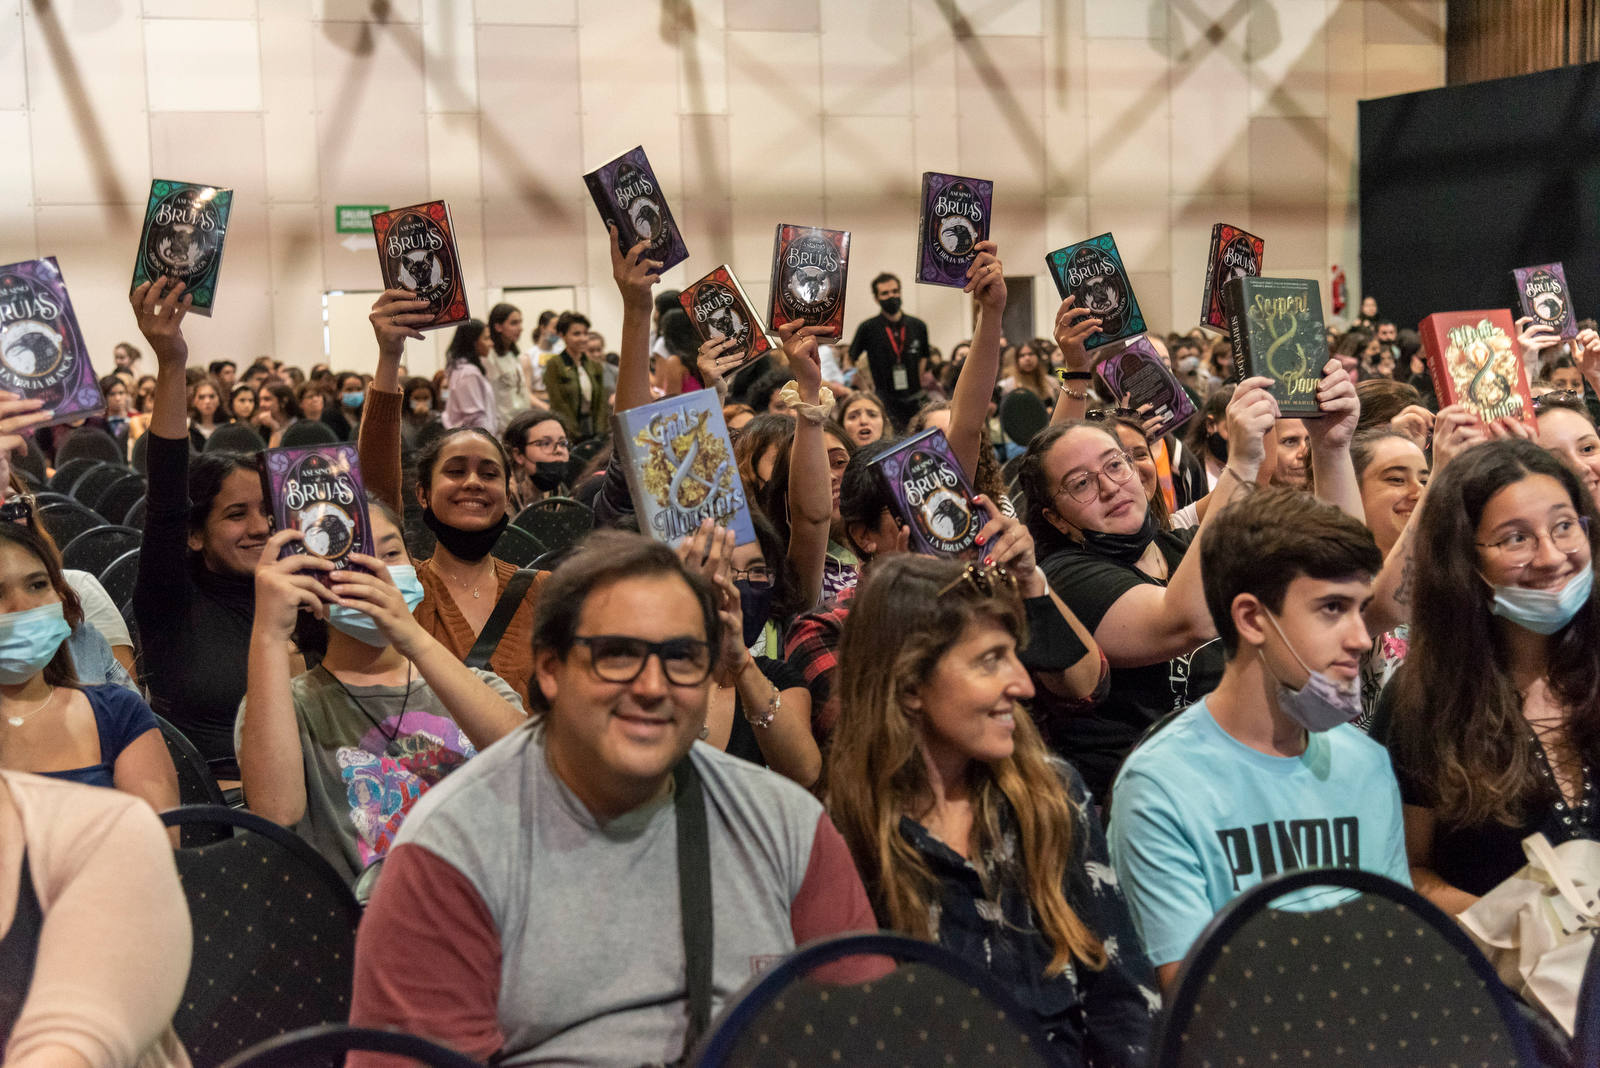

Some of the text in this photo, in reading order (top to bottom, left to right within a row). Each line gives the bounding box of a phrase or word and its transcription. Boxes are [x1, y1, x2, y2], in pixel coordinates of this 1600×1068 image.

[615, 173, 653, 210] BRUJAS
[156, 203, 215, 232] BRUJAS
[935, 196, 982, 222] BRUJAS
[388, 227, 443, 259] BRUJAS
[400, 222, 424, 232] ASESINO
[786, 248, 838, 272] BRUJAS
[1068, 256, 1115, 287] BRUJAS
[1223, 247, 1256, 277] BRUJAS
[1526, 279, 1562, 298] BRUJAS
[0, 292, 57, 326] RUJAS
[694, 288, 734, 323] BRUJAS
[648, 405, 699, 446] Gods
[287, 476, 354, 510] BRUJAS
[904, 462, 957, 506] BRUJAS
[653, 489, 744, 543] Monsters
[1215, 816, 1360, 892] PUMA
